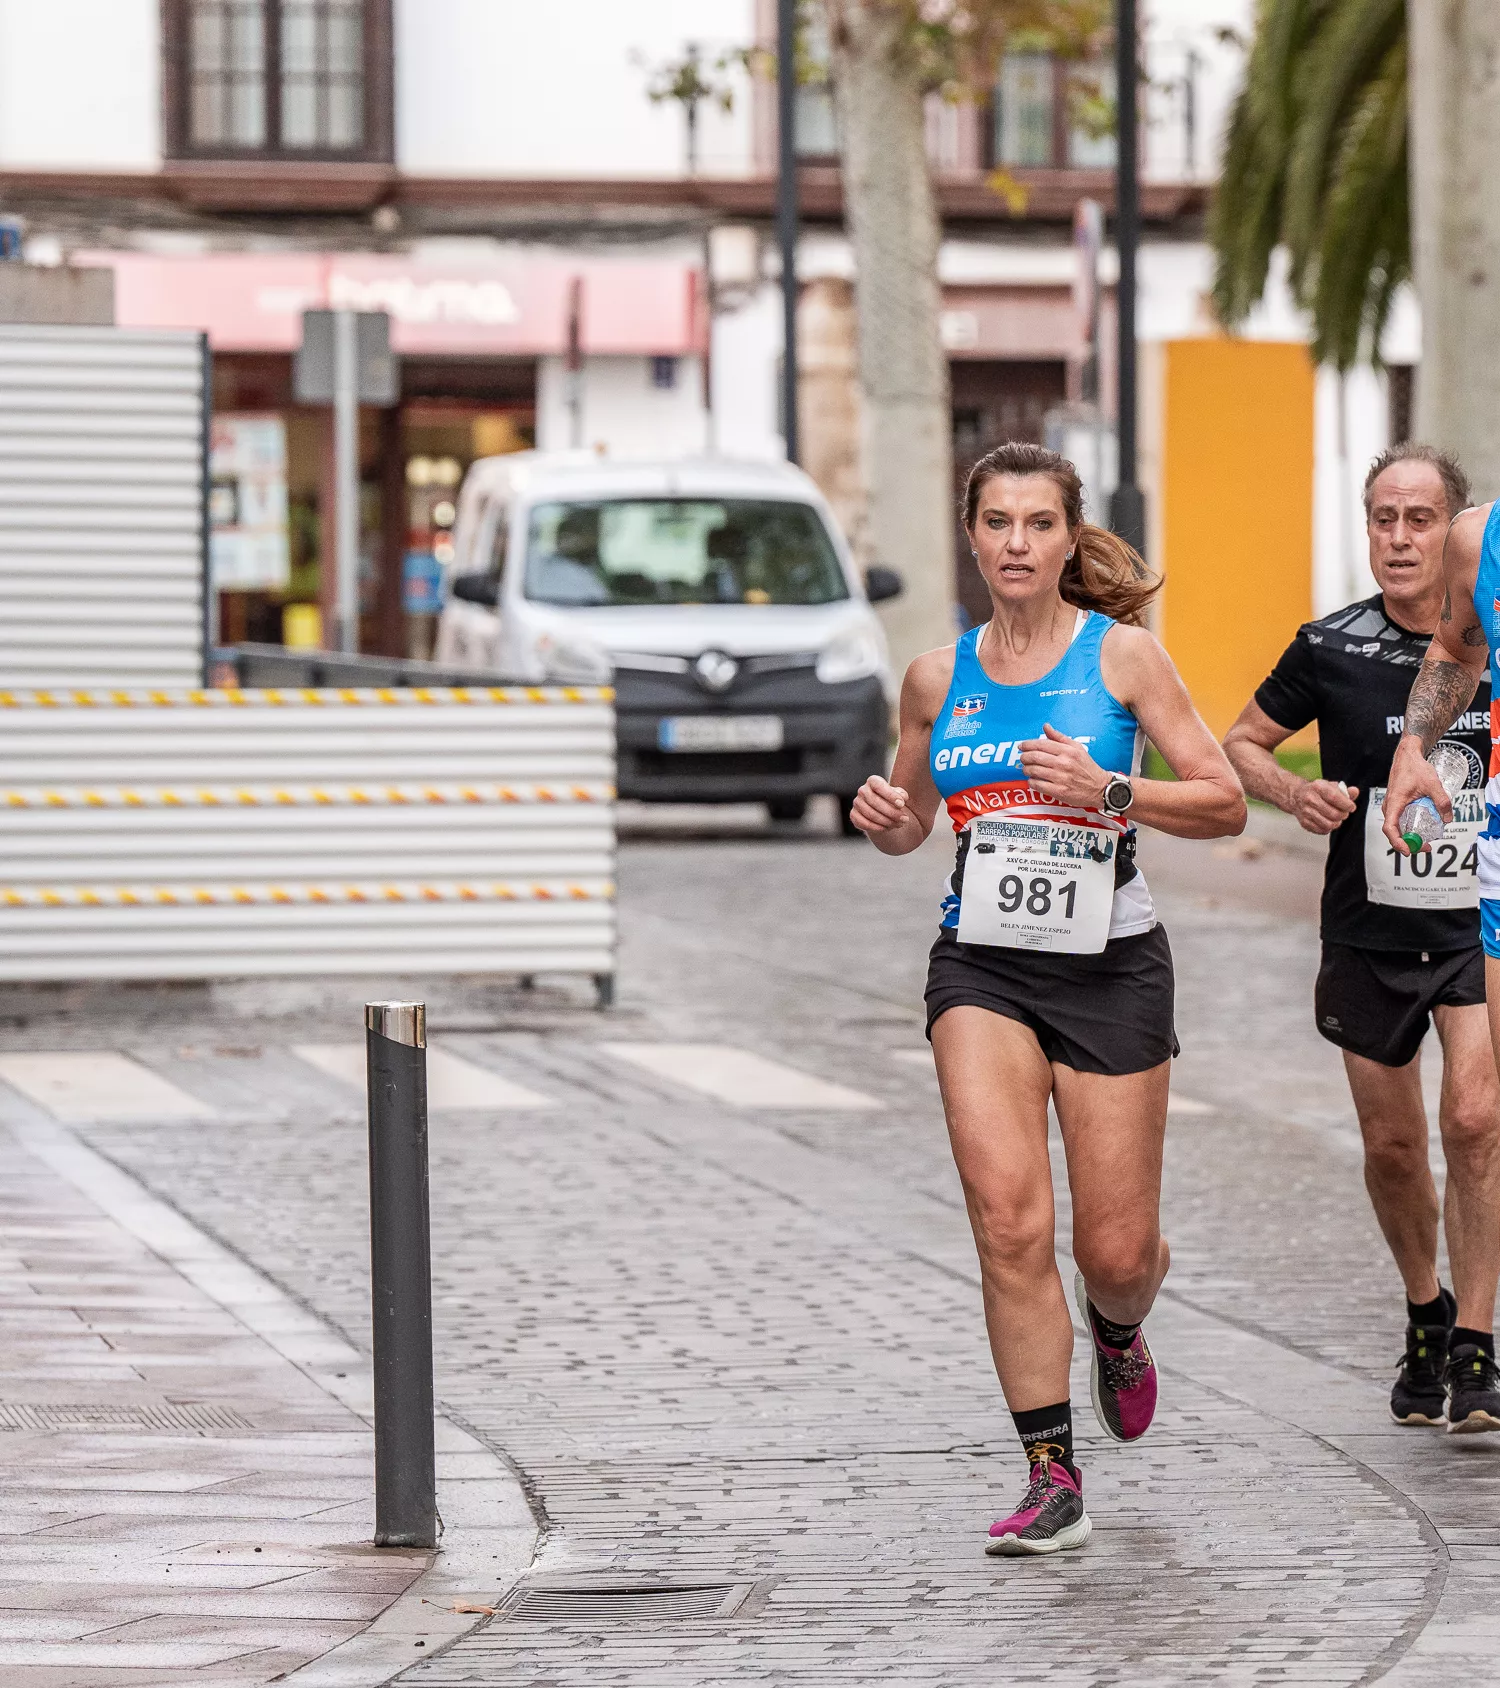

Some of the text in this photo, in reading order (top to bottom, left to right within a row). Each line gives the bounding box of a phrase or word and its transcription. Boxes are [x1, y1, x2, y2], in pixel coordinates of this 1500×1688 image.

[934, 733, 1091, 772] enerps
[976, 821, 1004, 830] CIRCUITO
[1005, 823, 1040, 833] PROVINCIAL
[976, 827, 1049, 840] CARRERAS POPULARES
[1050, 827, 1085, 844] 2024
[1060, 862, 1082, 870] LUCENA
[1386, 844, 1479, 878] 1024
[1038, 868, 1067, 876] IGUALDAD
[997, 874, 1077, 919] 981
[1020, 924, 1048, 933] JIMENEZ
[1048, 927, 1071, 935] ESPEJO
